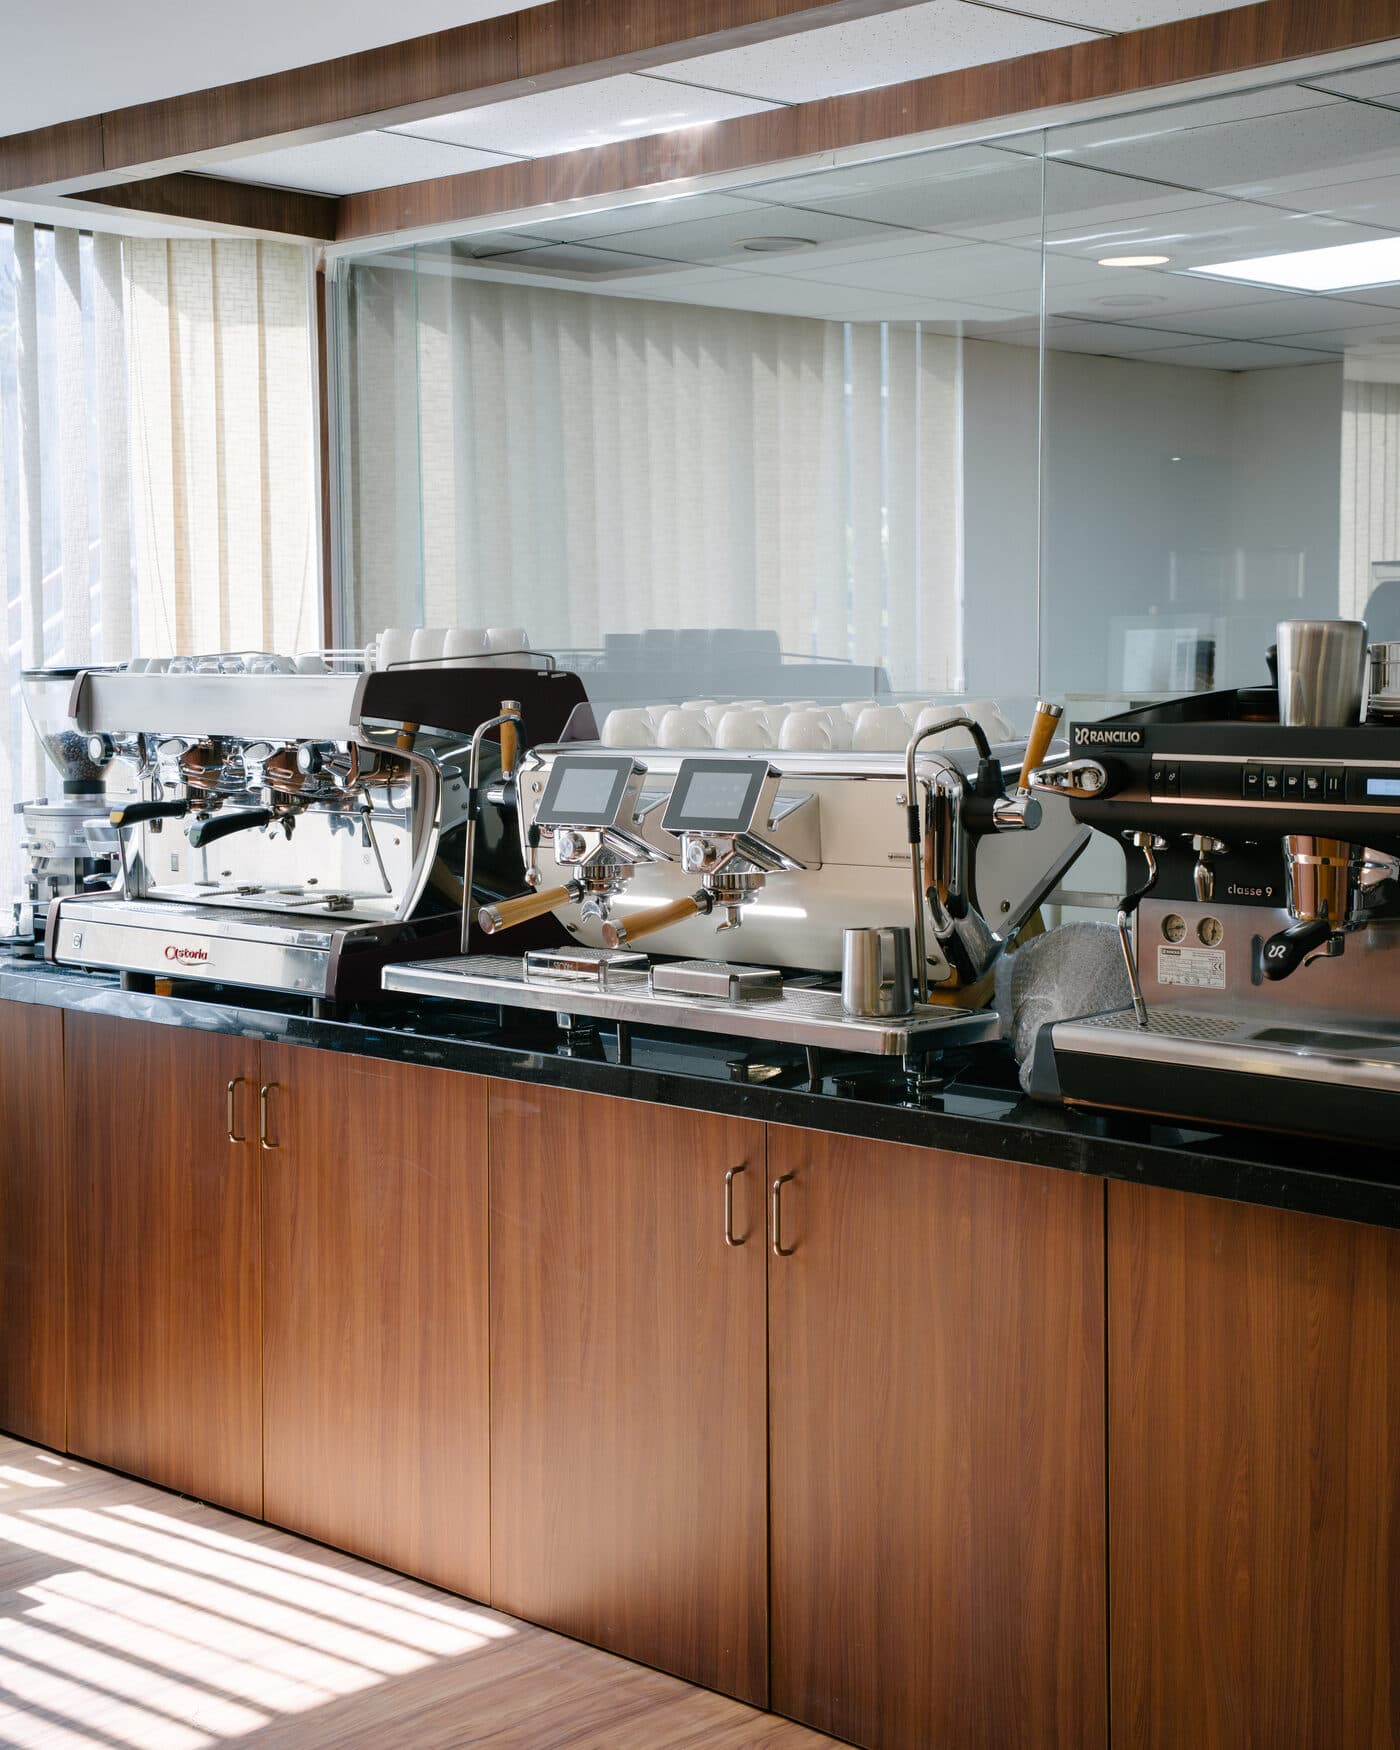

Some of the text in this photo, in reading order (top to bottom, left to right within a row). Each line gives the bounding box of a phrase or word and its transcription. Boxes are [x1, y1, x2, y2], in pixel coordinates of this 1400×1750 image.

[1090, 730, 1140, 743] RANCILIO
[1227, 883, 1273, 897] classe 9
